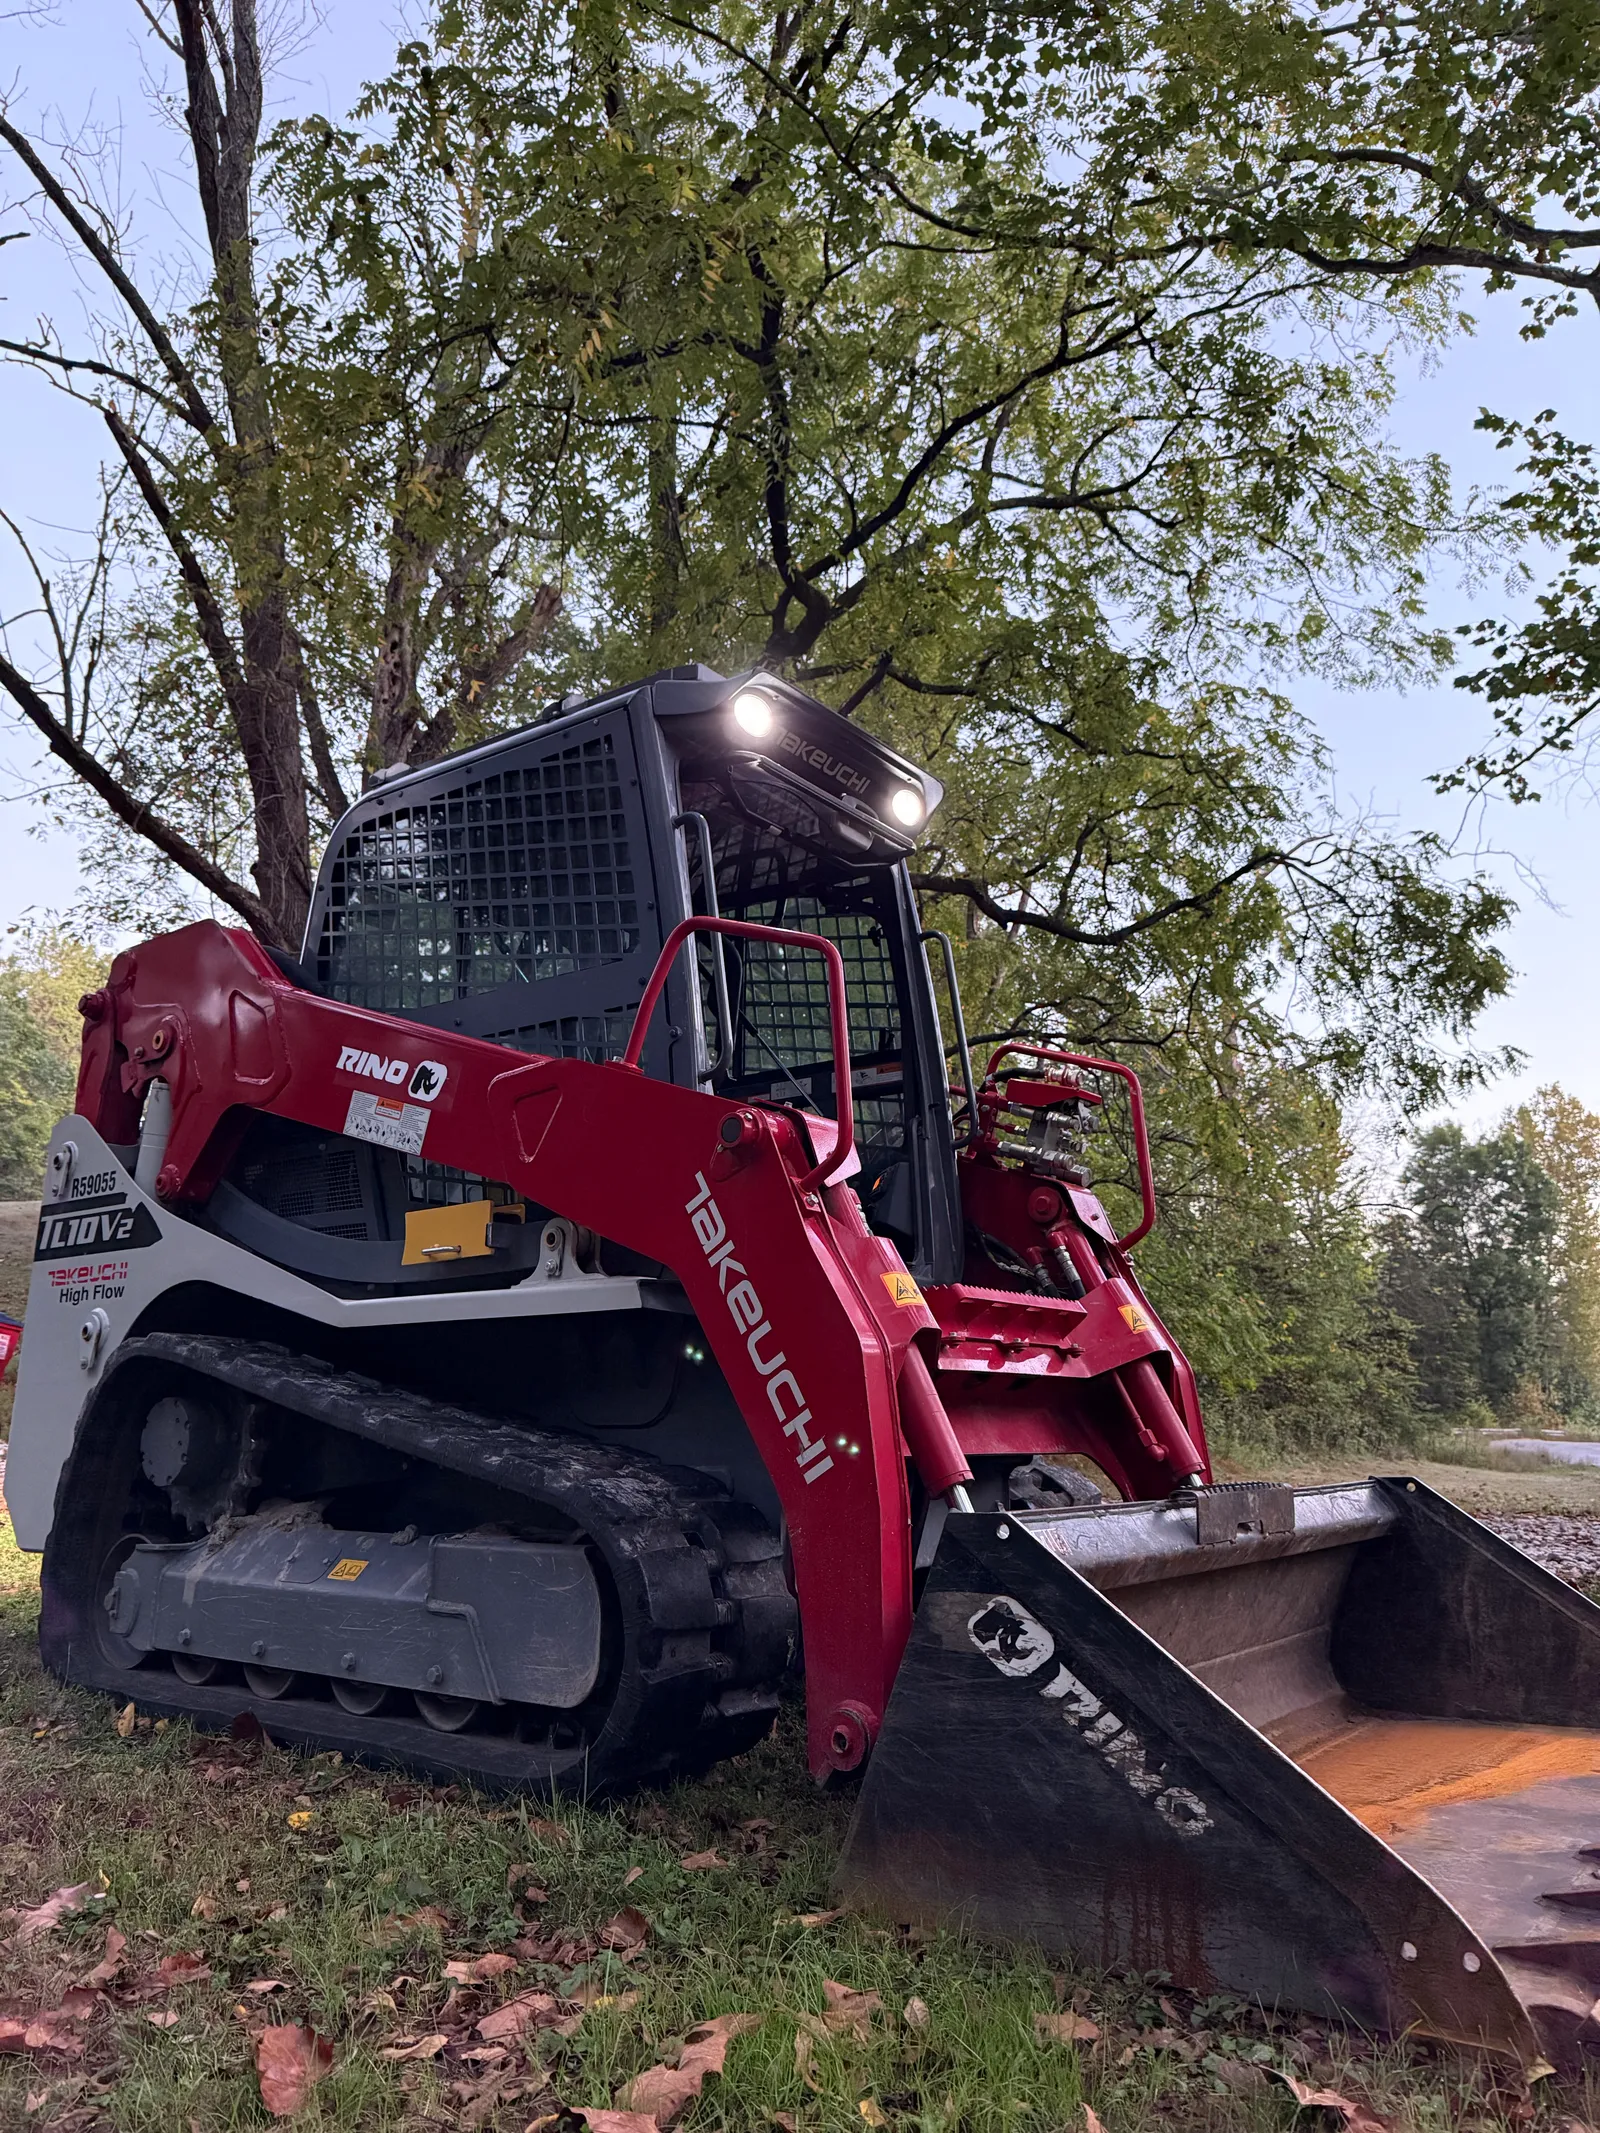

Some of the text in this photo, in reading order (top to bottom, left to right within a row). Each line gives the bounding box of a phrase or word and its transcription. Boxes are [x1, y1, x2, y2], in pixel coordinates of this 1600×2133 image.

[336, 1045, 409, 1085] RINO
[71, 1170, 117, 1198] R59055
[48, 1262, 128, 1287] TAKEUCHI
[59, 1284, 125, 1306] High Flow
[685, 1170, 834, 1485] TAKEUCHI
